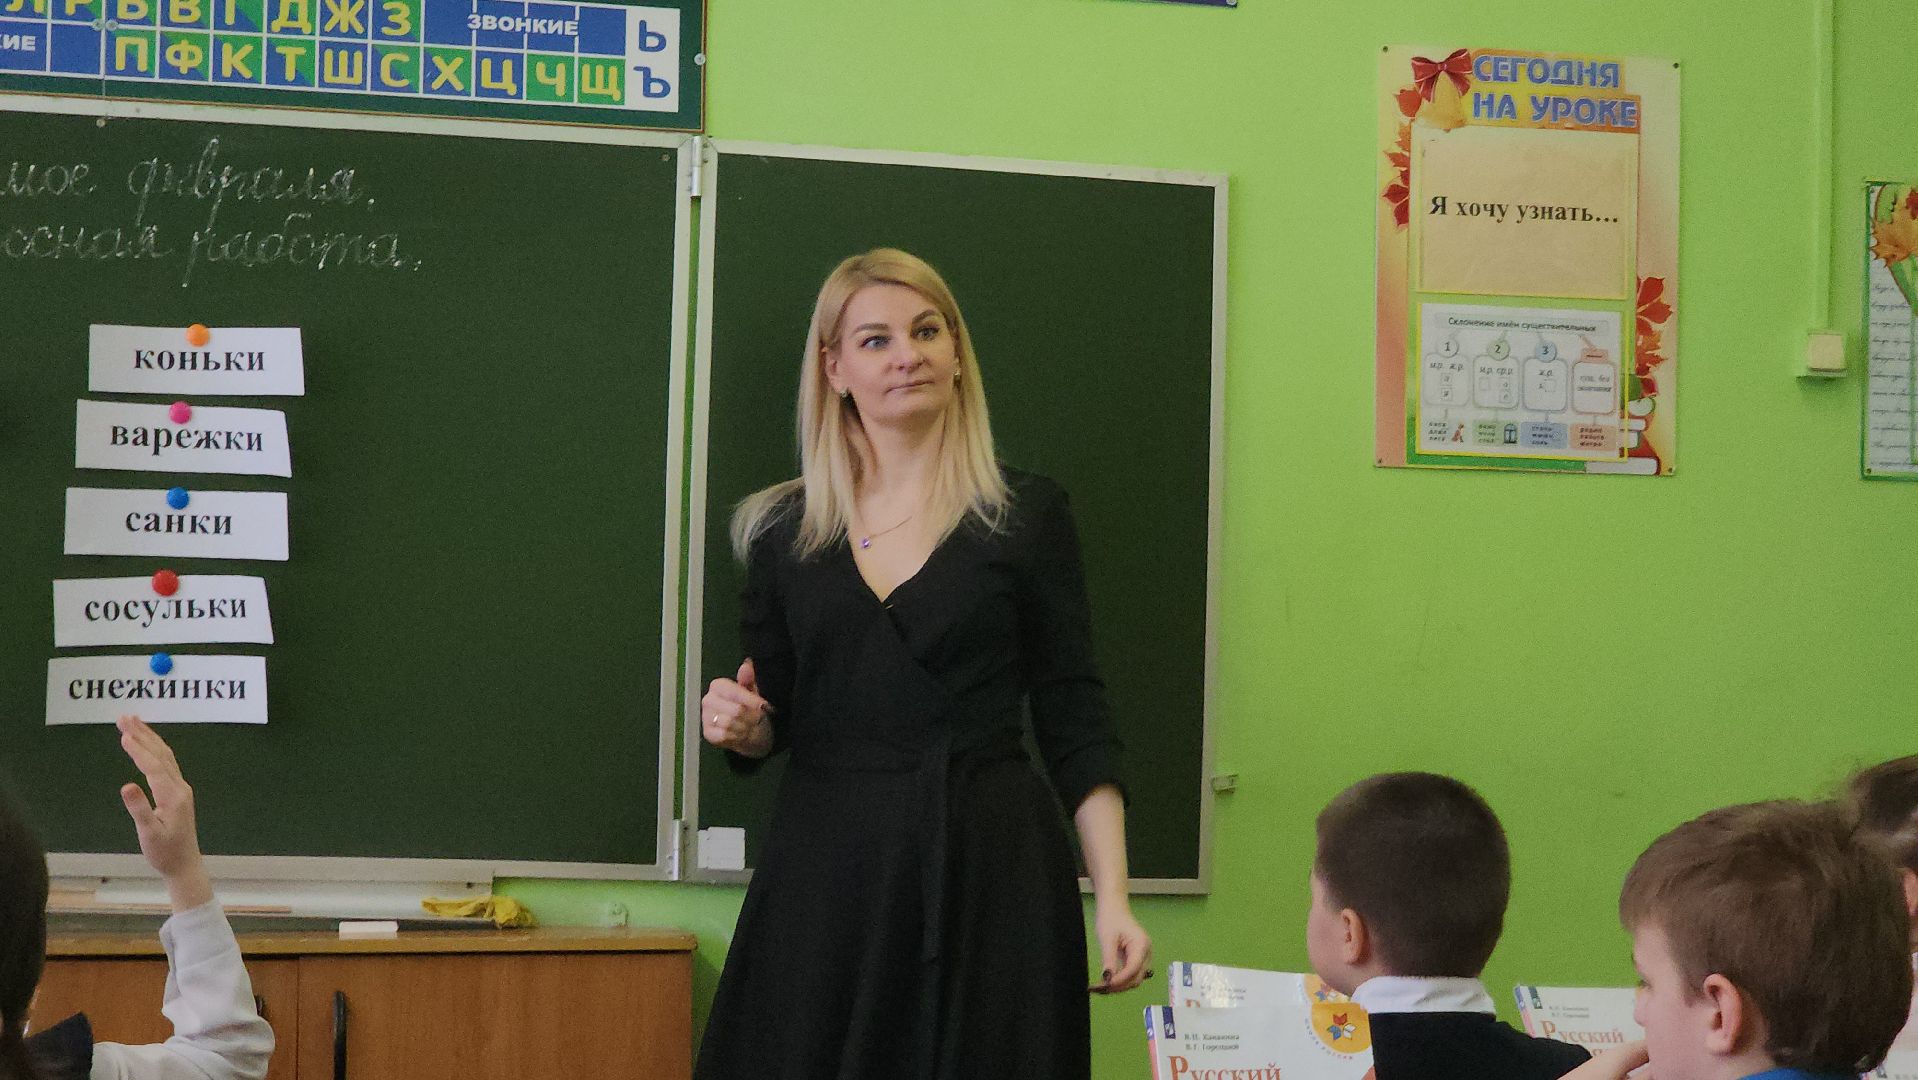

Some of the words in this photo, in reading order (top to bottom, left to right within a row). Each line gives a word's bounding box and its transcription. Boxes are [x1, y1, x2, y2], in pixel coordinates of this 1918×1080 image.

[271, 0, 312, 35] Д
[324, 0, 365, 34] Ж
[382, 2, 412, 36] З
[467, 14, 579, 36] ЗВОНКИЕ
[0, 34, 36, 51] ИЕ
[116, 36, 149, 73] П
[165, 39, 203, 75] Ф
[221, 43, 254, 79] К
[276, 46, 307, 82] Т
[324, 49, 363, 85] Ш
[381, 53, 410, 88] С
[431, 56, 465, 91] Х
[481, 58, 517, 96] Ц
[536, 61, 566, 97] Ч
[582, 64, 622, 101] Щ
[1473, 55, 1619, 88] СЕГОДНЯ
[1473, 92, 1517, 120] НА
[1530, 95, 1638, 127] УРОКЕ
[1428, 195, 1449, 216] Я
[1455, 202, 1510, 224] хочу
[1448, 317, 1495, 328] Склонение
[1521, 321, 1597, 333] существительных
[1444, 341, 1450, 352] 1
[1494, 344, 1501, 354] 2
[1542, 345, 1549, 355] 3
[133, 349, 265, 372] коньки
[110, 424, 263, 456] варежки
[125, 510, 233, 536] санки
[84, 597, 247, 627] сосульки
[68, 678, 247, 700] снежинки
[1167, 1055, 1282, 1080] Русский
